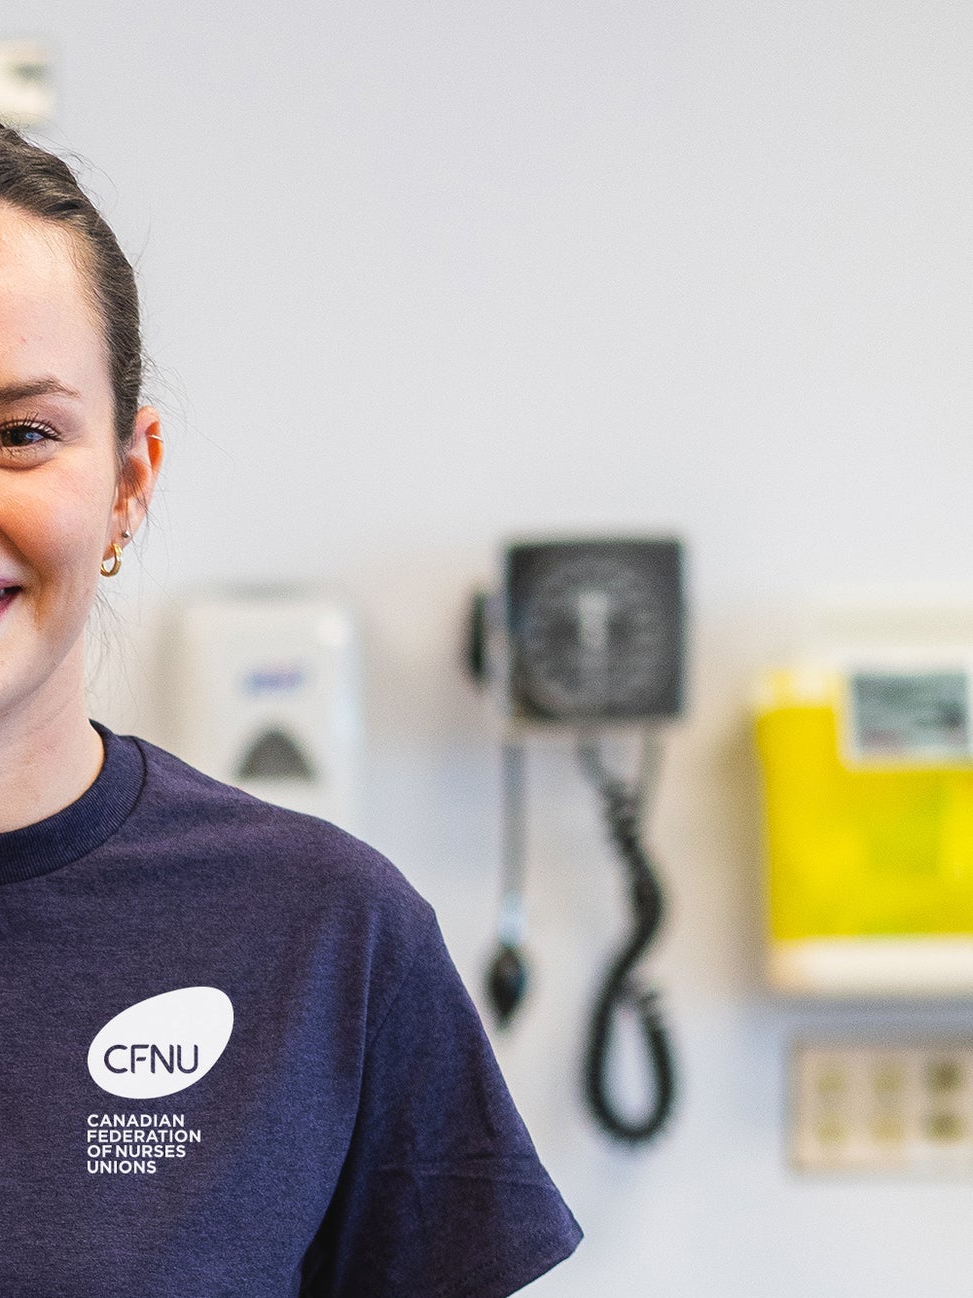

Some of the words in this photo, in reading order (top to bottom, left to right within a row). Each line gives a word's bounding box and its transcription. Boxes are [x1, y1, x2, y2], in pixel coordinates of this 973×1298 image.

[103, 1044, 199, 1074] CFNU
[87, 1114, 185, 1127] CANADIAN
[87, 1130, 201, 1142] FEDERATION
[87, 1145, 113, 1158] OF
[115, 1145, 186, 1158] NURSES
[87, 1160, 157, 1174] UNIONS
